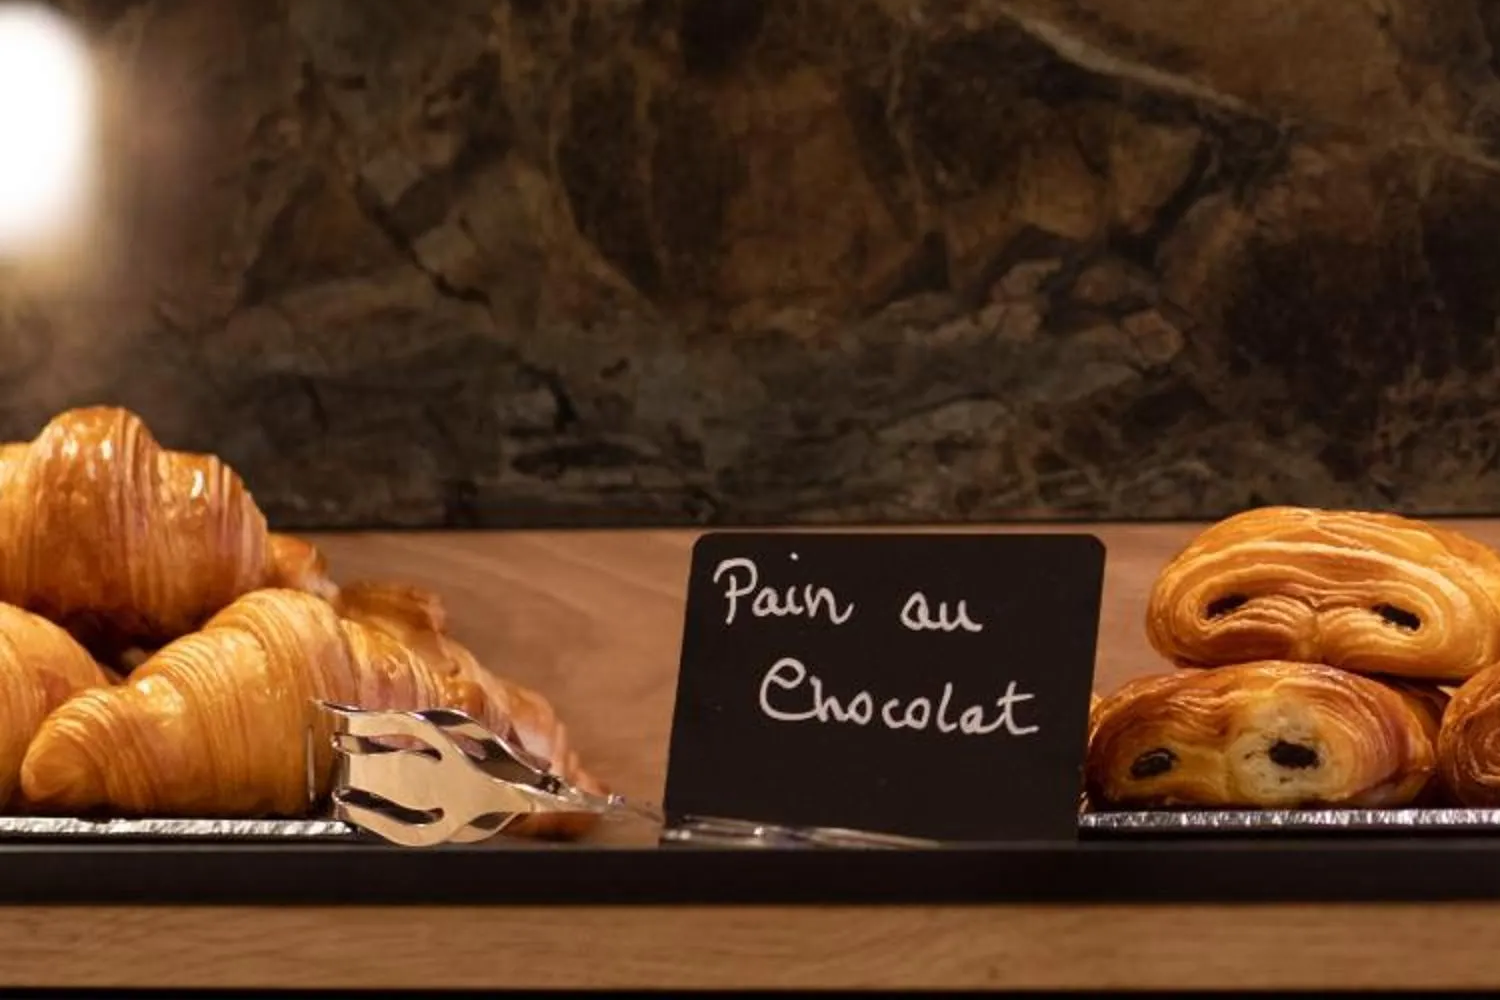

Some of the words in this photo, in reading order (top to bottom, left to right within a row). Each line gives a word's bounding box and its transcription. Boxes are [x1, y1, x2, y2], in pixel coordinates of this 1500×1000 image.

[713, 552, 854, 625] Pain
[900, 591, 983, 632] au
[759, 657, 1039, 736] Chocolat
